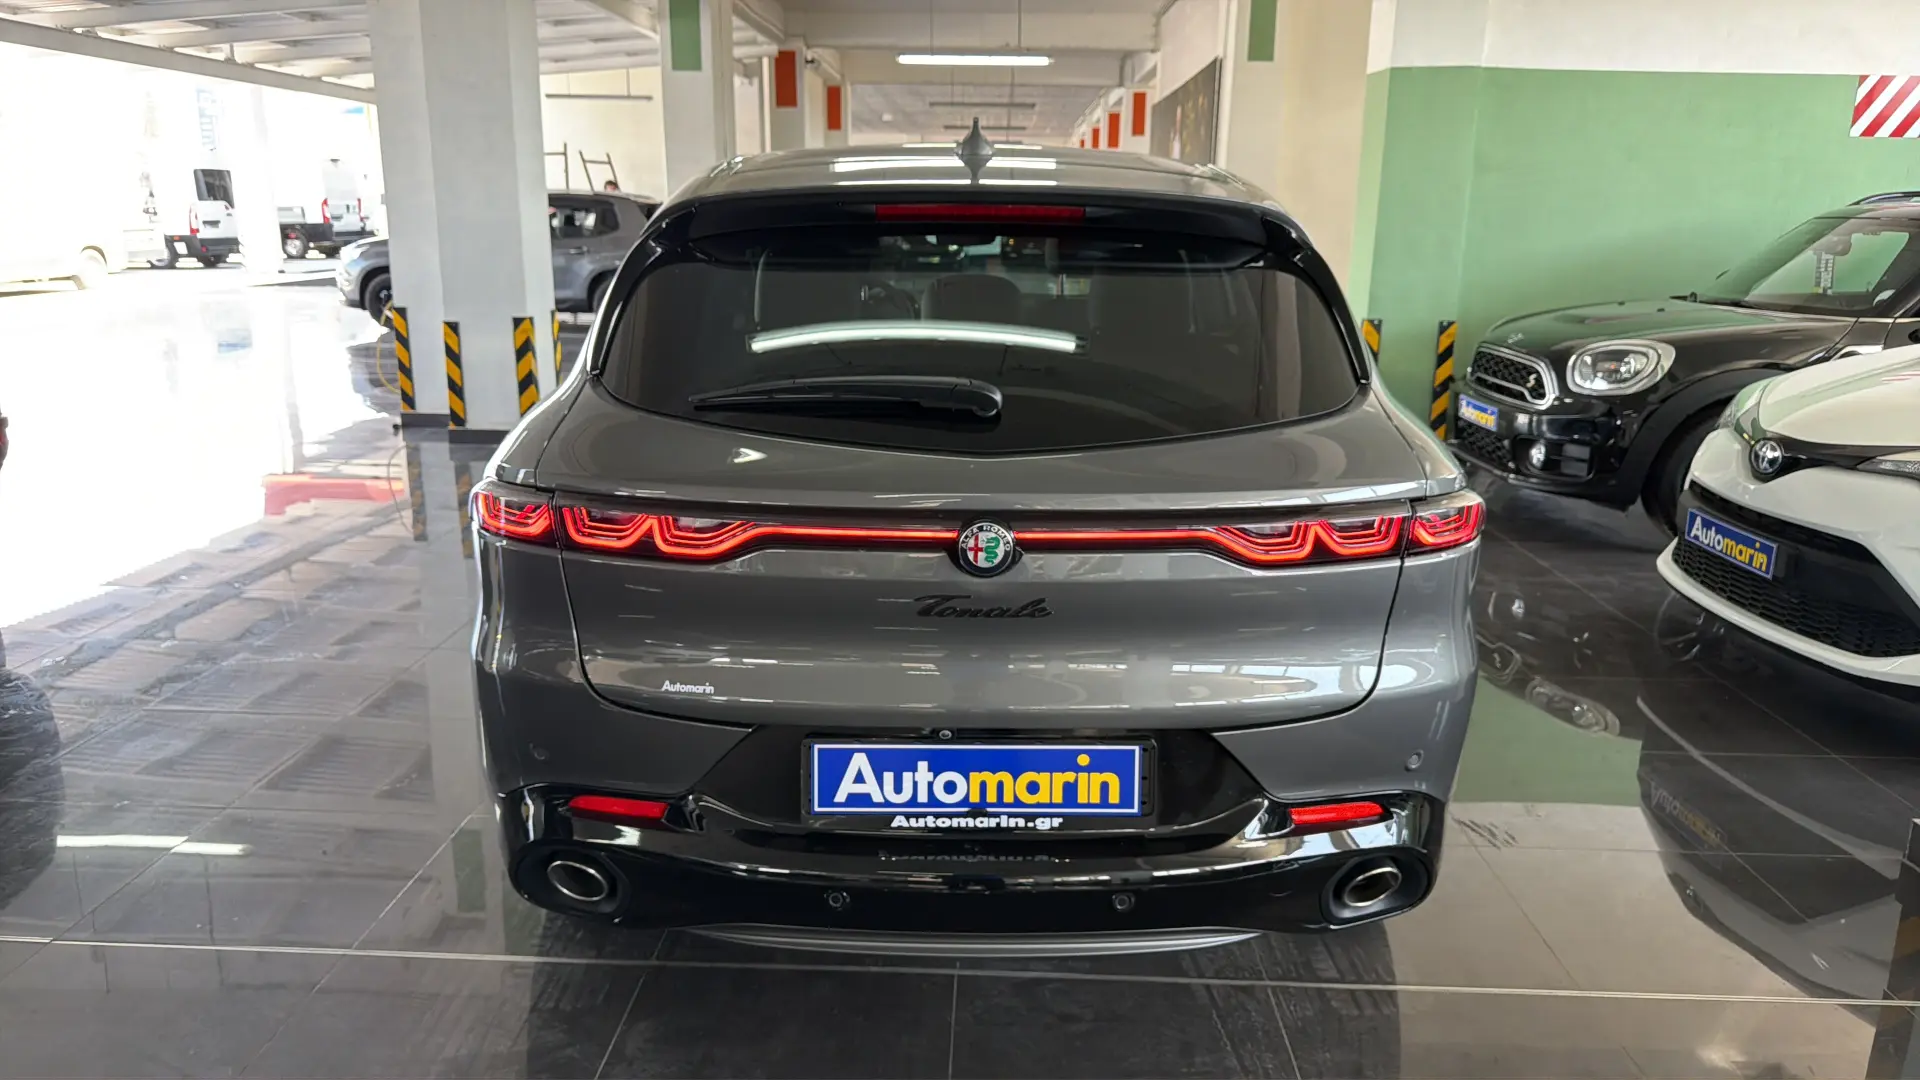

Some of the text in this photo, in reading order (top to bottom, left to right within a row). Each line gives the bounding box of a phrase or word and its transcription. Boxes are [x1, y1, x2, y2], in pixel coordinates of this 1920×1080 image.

[962, 526, 1010, 551] ALFA ROMEO
[1690, 515, 1767, 572] Automarin
[914, 594, 1054, 618] Tonale
[661, 680, 714, 694] Automarin
[833, 752, 1120, 804] Automarin
[891, 815, 1063, 830] Automarin.gr
